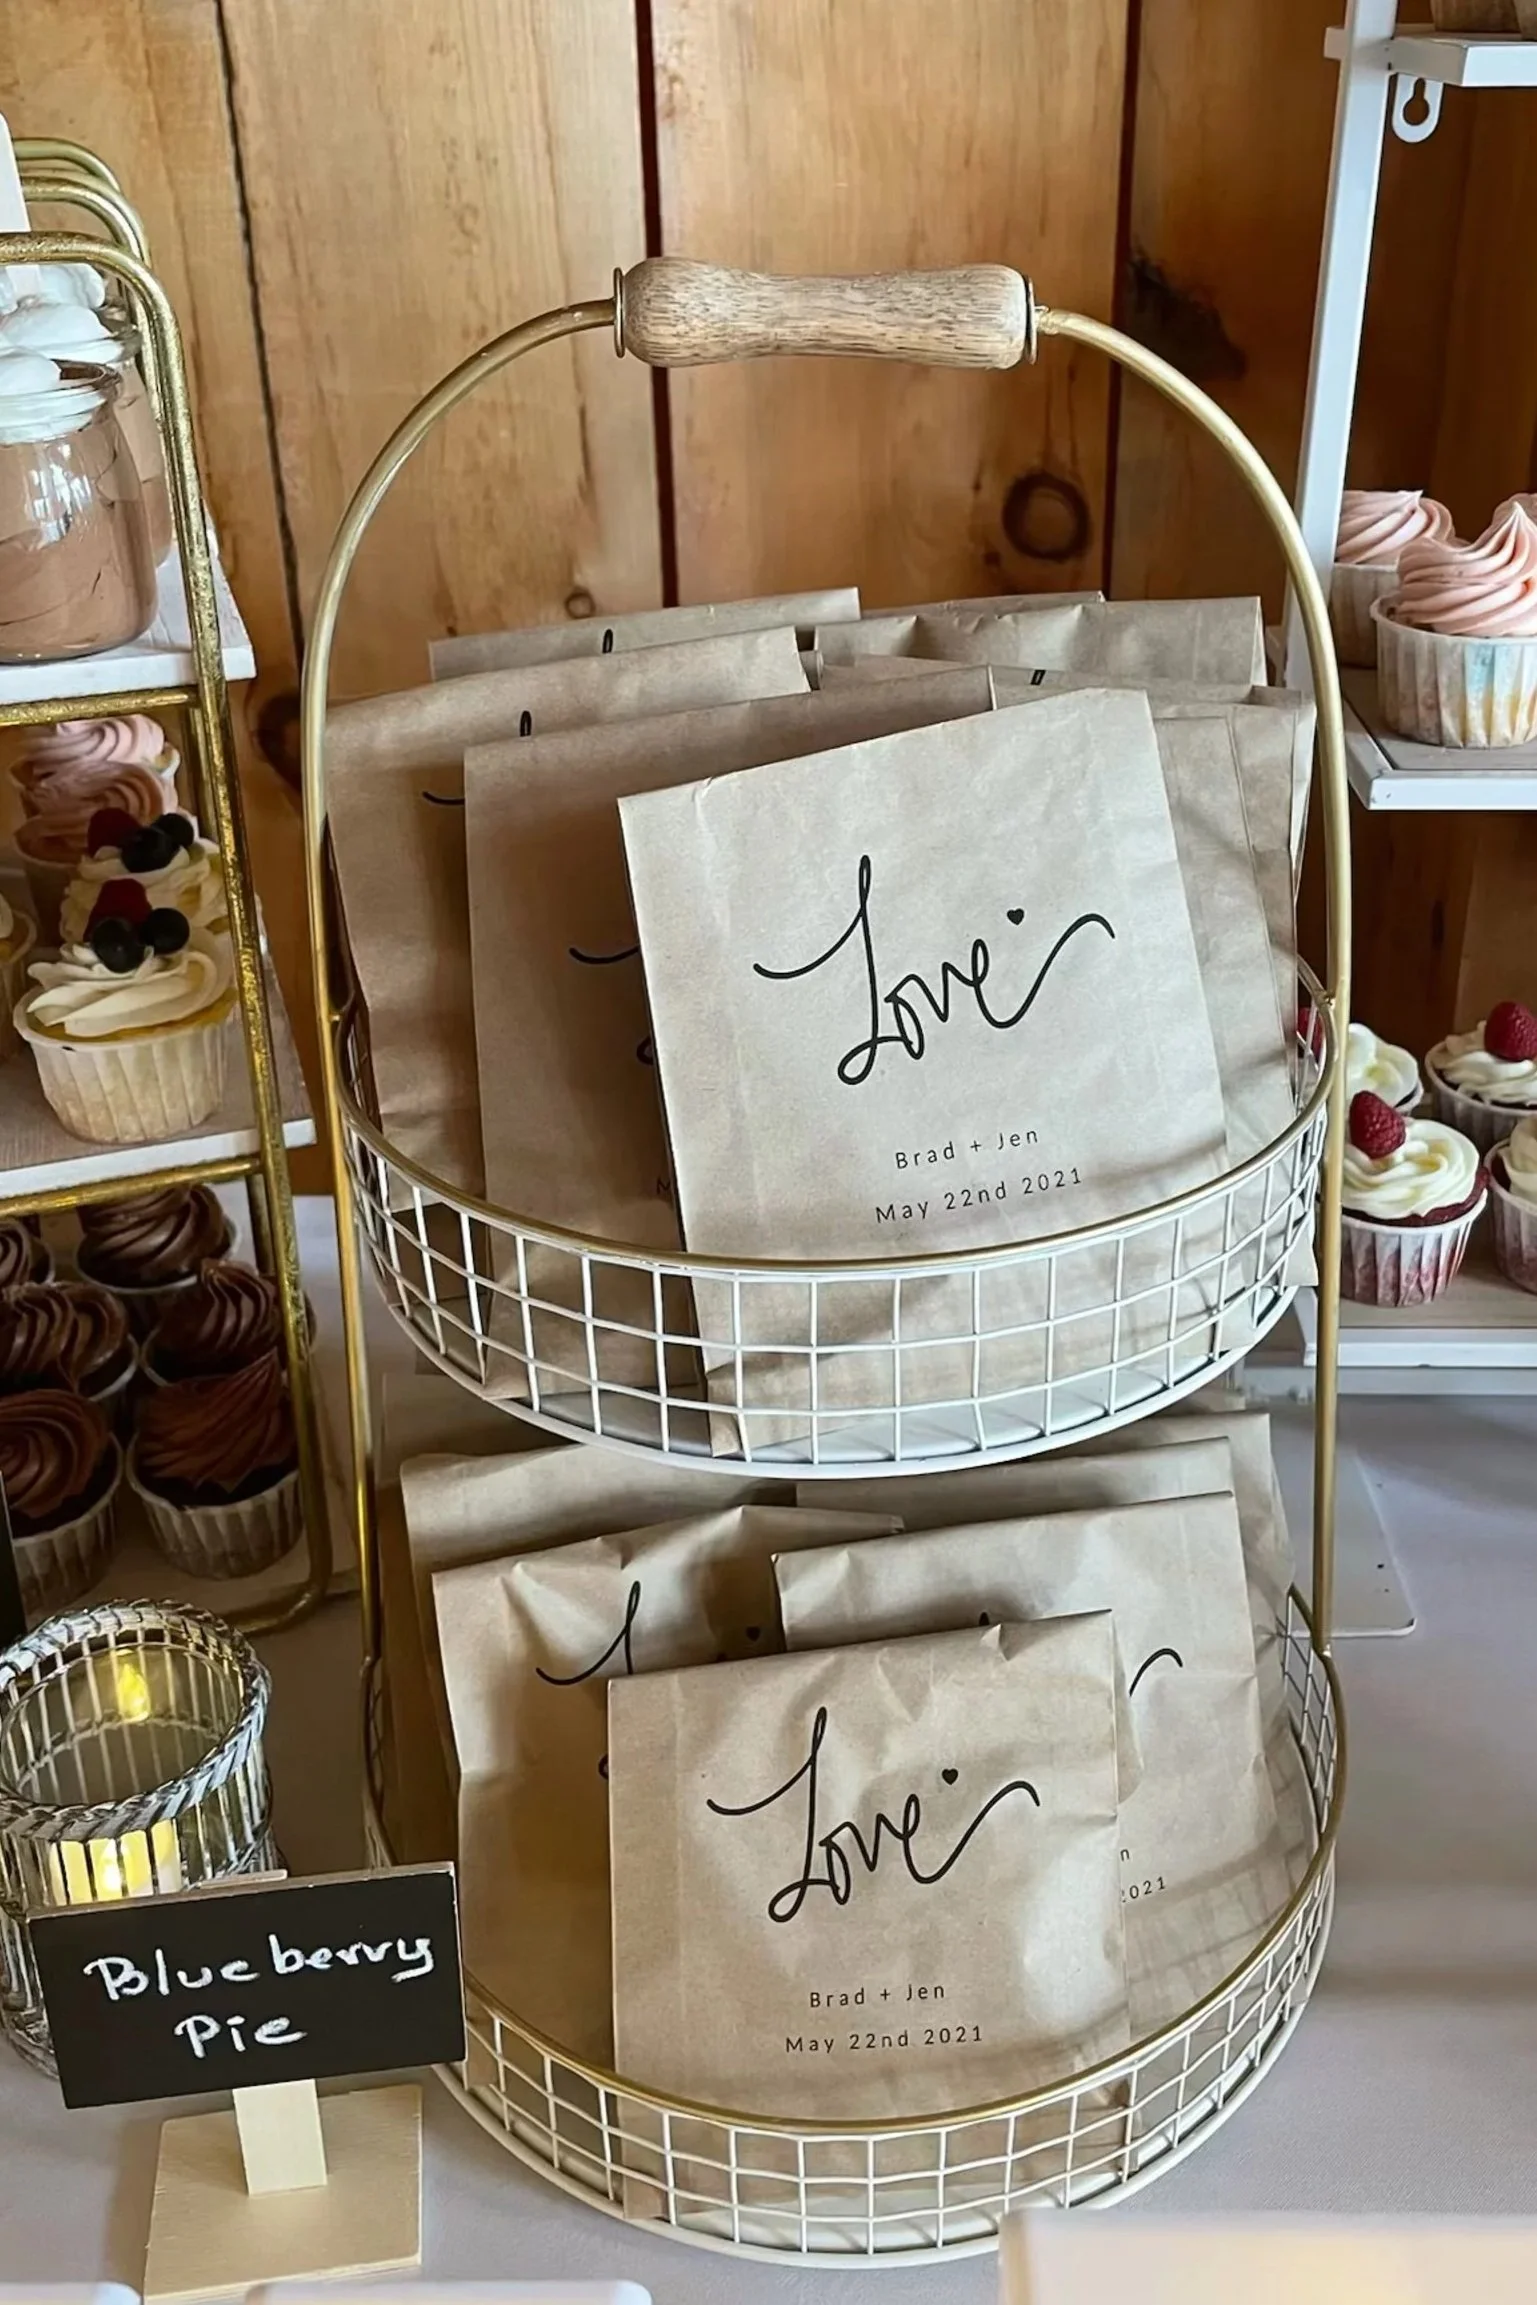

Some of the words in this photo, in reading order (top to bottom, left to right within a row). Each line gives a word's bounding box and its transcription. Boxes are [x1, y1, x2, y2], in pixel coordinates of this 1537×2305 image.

[753, 855, 1116, 1086] Love
[895, 1140, 955, 1170] Brad
[997, 1130, 1038, 1151] Jen
[875, 1201, 929, 1224] May
[943, 1181, 1007, 1211] 22nd
[1022, 1167, 1082, 1195] 2021
[706, 1707, 1041, 1923] Love
[809, 1986, 865, 2008] Brad
[906, 1983, 945, 2001] Jen
[174, 2015, 307, 2059] Pie
[785, 2036, 835, 2054] May
[849, 2029, 909, 2050] 22nd
[923, 2025, 983, 2046] 2021
